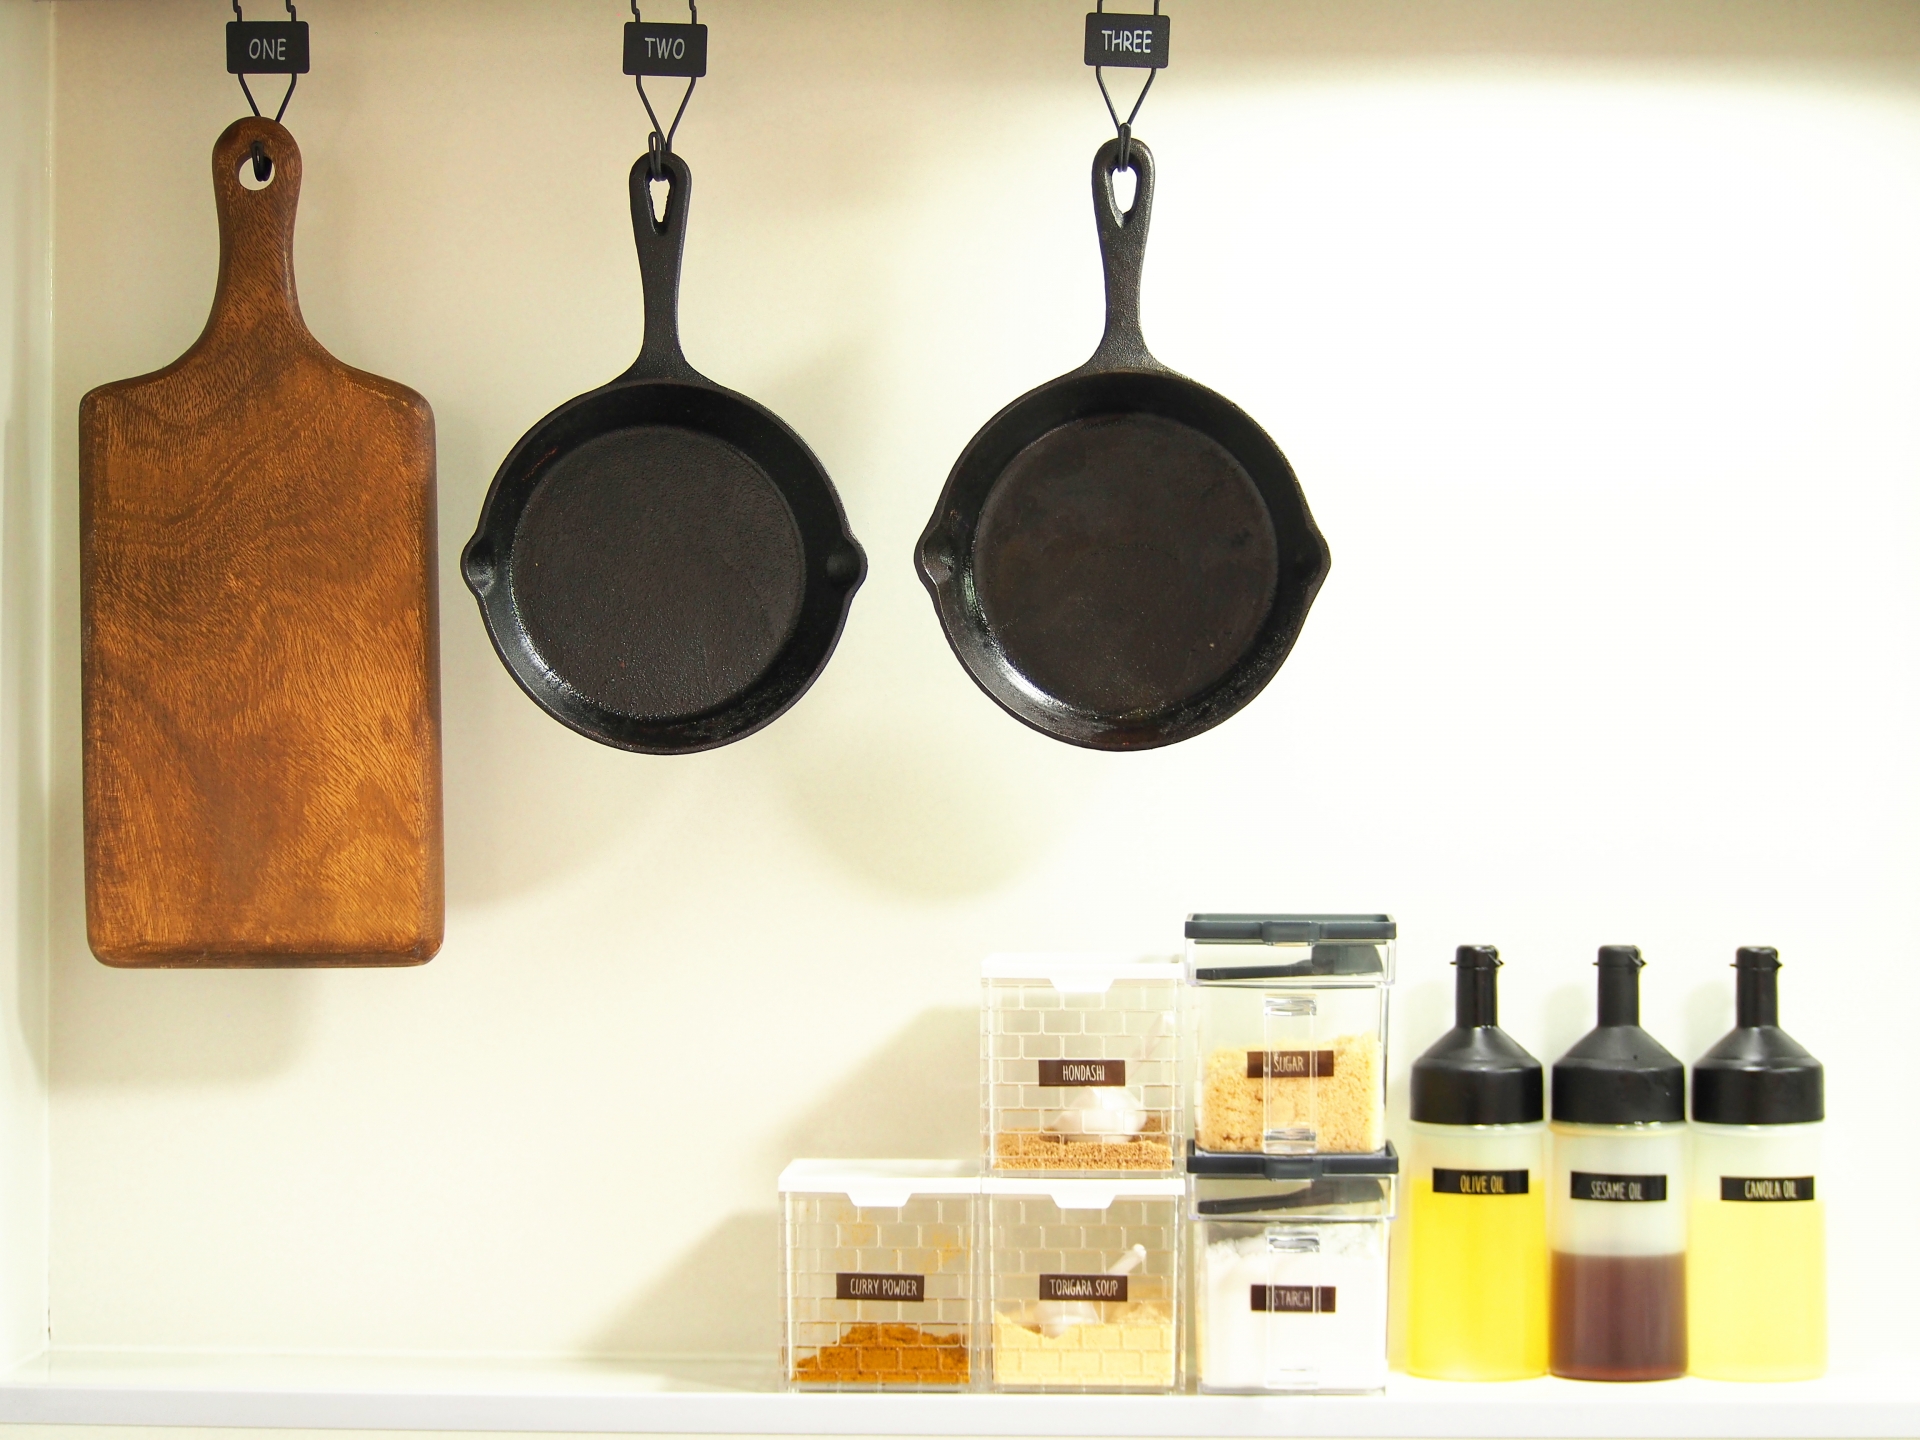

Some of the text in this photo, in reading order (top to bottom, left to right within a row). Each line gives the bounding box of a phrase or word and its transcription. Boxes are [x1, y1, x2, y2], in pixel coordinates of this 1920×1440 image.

[248, 38, 287, 60] ONE
[644, 37, 685, 60] TWO
[1101, 29, 1153, 53] THREE
[1062, 1064, 1105, 1082] HONDASHI
[1273, 1055, 1305, 1073] SUGAR
[1460, 1175, 1505, 1194] OLIVE OIL
[1590, 1181, 1643, 1201] SESAME OIL
[1744, 1180, 1797, 1199] CANOLA OIL
[850, 1278, 918, 1297] CURRY POWDER
[1050, 1279, 1119, 1297] TORIGARA SOUP
[1273, 1290, 1311, 1308] STARCH
